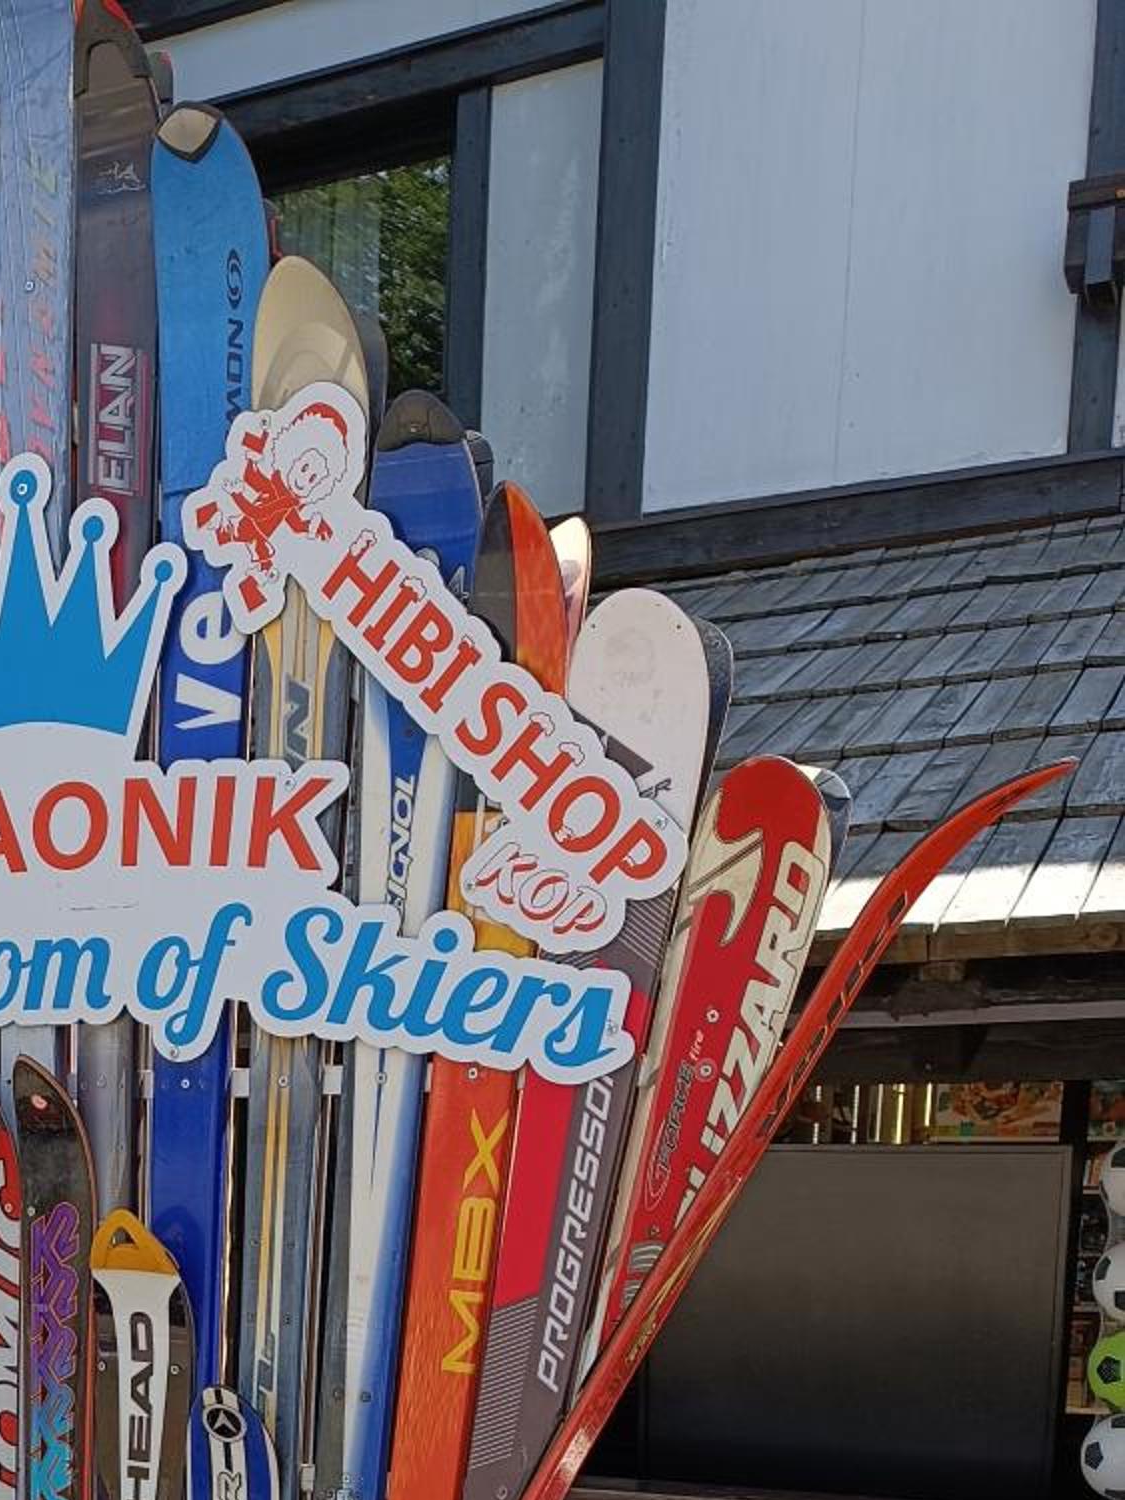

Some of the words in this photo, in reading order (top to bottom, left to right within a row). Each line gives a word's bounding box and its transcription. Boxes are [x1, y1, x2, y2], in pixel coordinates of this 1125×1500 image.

[98, 344, 139, 496] ELAN
[321, 536, 483, 714] HIBI
[455, 680, 669, 886] SHOP
[386, 774, 415, 906] IGNOL
[475, 842, 610, 936] KOP
[136, 901, 254, 1047] of
[261, 906, 616, 1068] Skiers
